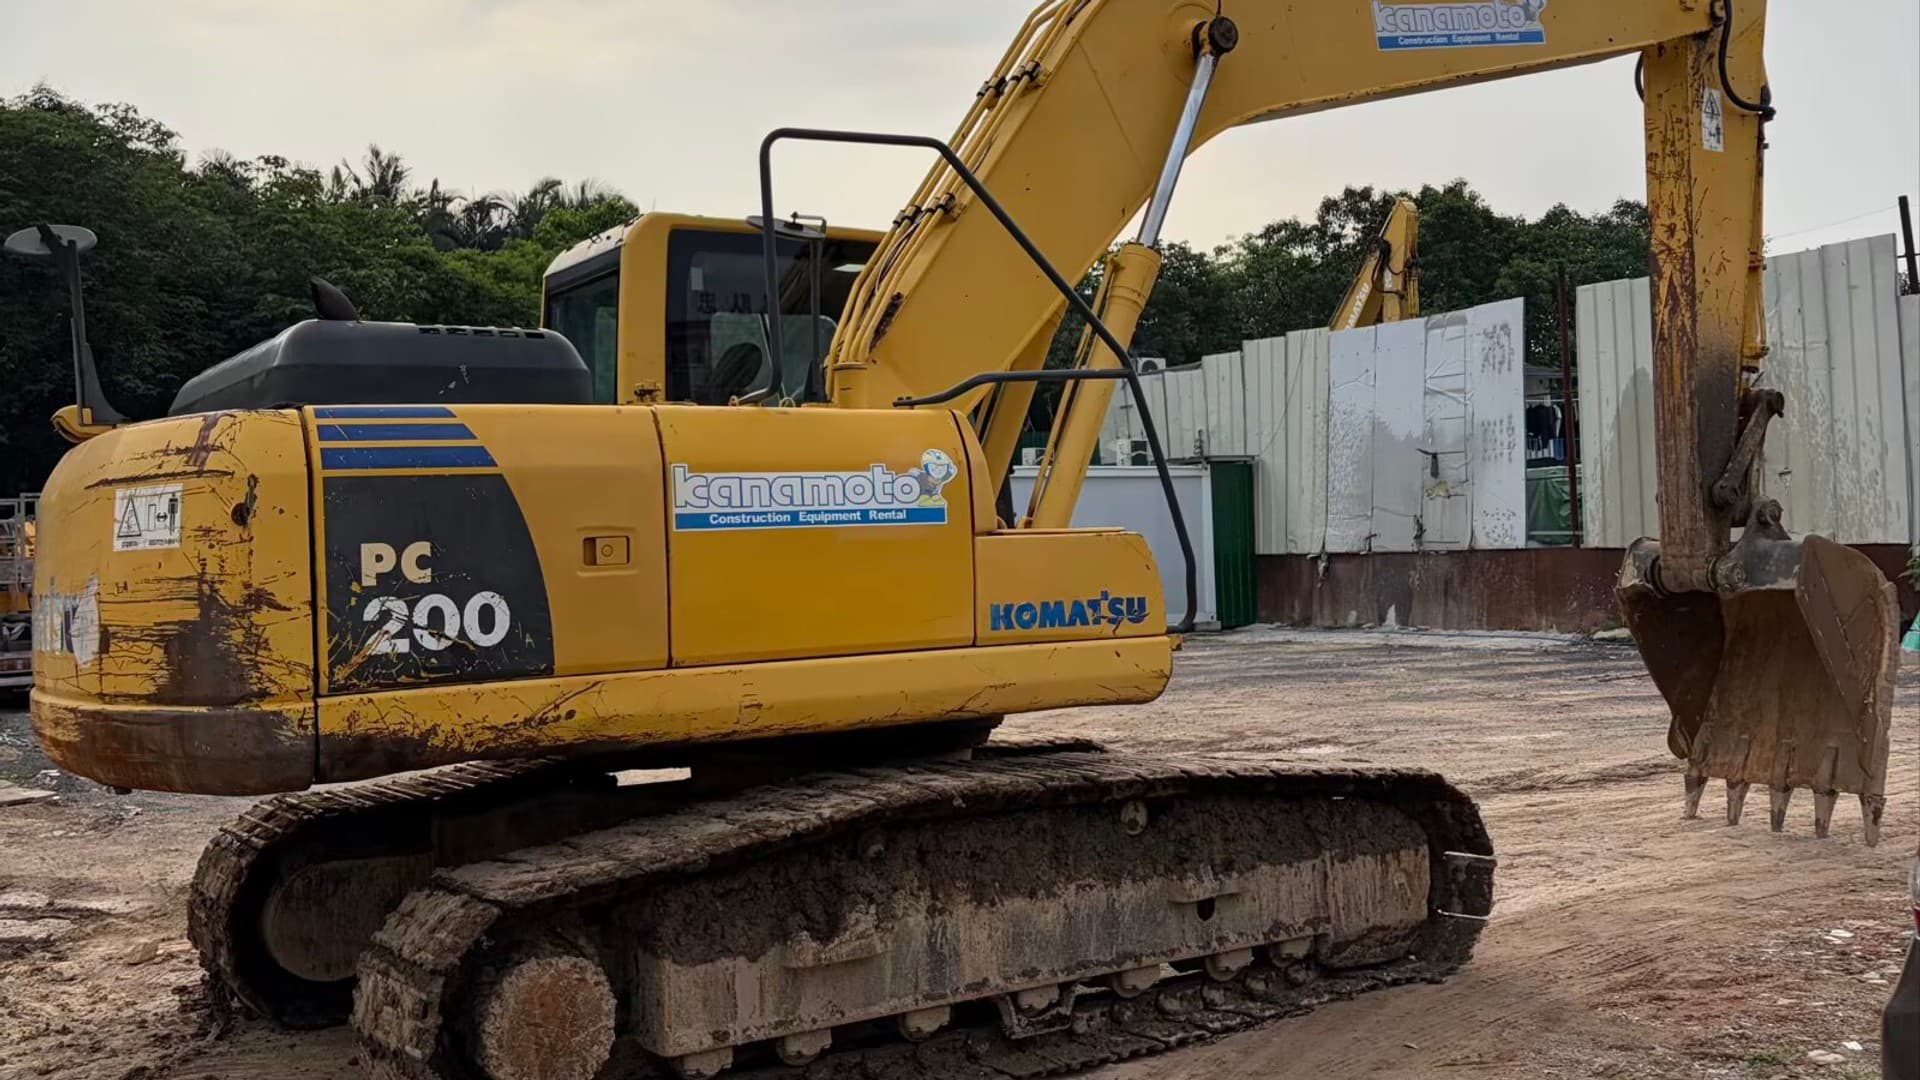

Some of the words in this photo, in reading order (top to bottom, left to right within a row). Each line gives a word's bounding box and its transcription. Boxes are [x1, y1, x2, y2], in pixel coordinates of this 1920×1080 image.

[1373, 0, 1527, 32] kanamoto
[1398, 36, 1449, 45] Construction
[1452, 34, 1491, 43] Equipment
[1495, 32, 1520, 41] Rental
[673, 465, 921, 508] kanamoto
[709, 512, 791, 525] Construction
[799, 510, 862, 523] Equipment
[869, 510, 907, 521] Rental
[360, 541, 432, 587] PC
[362, 591, 511, 656] 200
[990, 590, 1147, 631] KOMATSU
